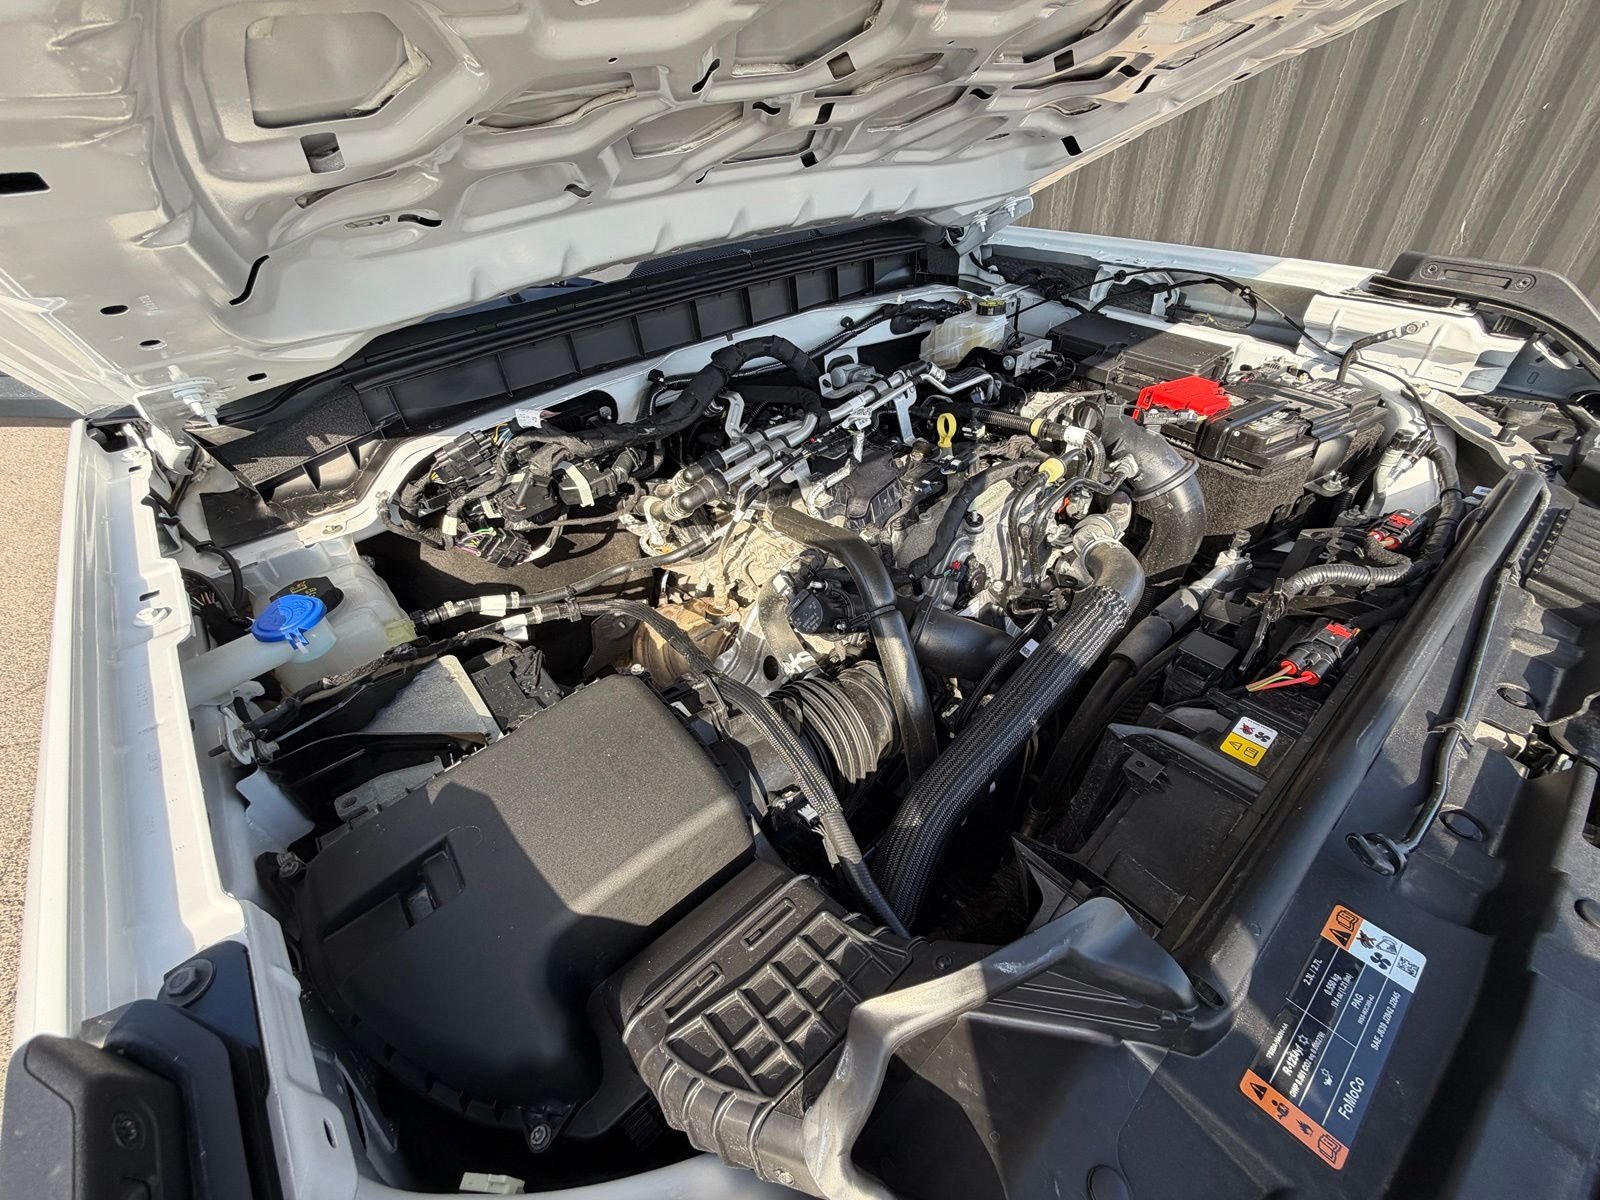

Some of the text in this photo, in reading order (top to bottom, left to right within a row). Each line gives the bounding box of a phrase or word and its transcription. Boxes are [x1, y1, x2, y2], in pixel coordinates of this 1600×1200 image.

[1303, 973, 1315, 986] 2.3L
[1311, 959, 1322, 971] 2.7L
[1324, 973, 1342, 995] 0.550 kg
[1351, 993, 1364, 1009] PAG
[1371, 991, 1401, 1050] SAE J639 J2842 J2845
[1282, 1043, 1303, 1076] R-1234yf
[1289, 1083, 1299, 1097] GWP
[1302, 1059, 1311, 1072] CO2
[1308, 1053, 1316, 1061] eq
[1338, 1077, 1364, 1120] FoMoCo
